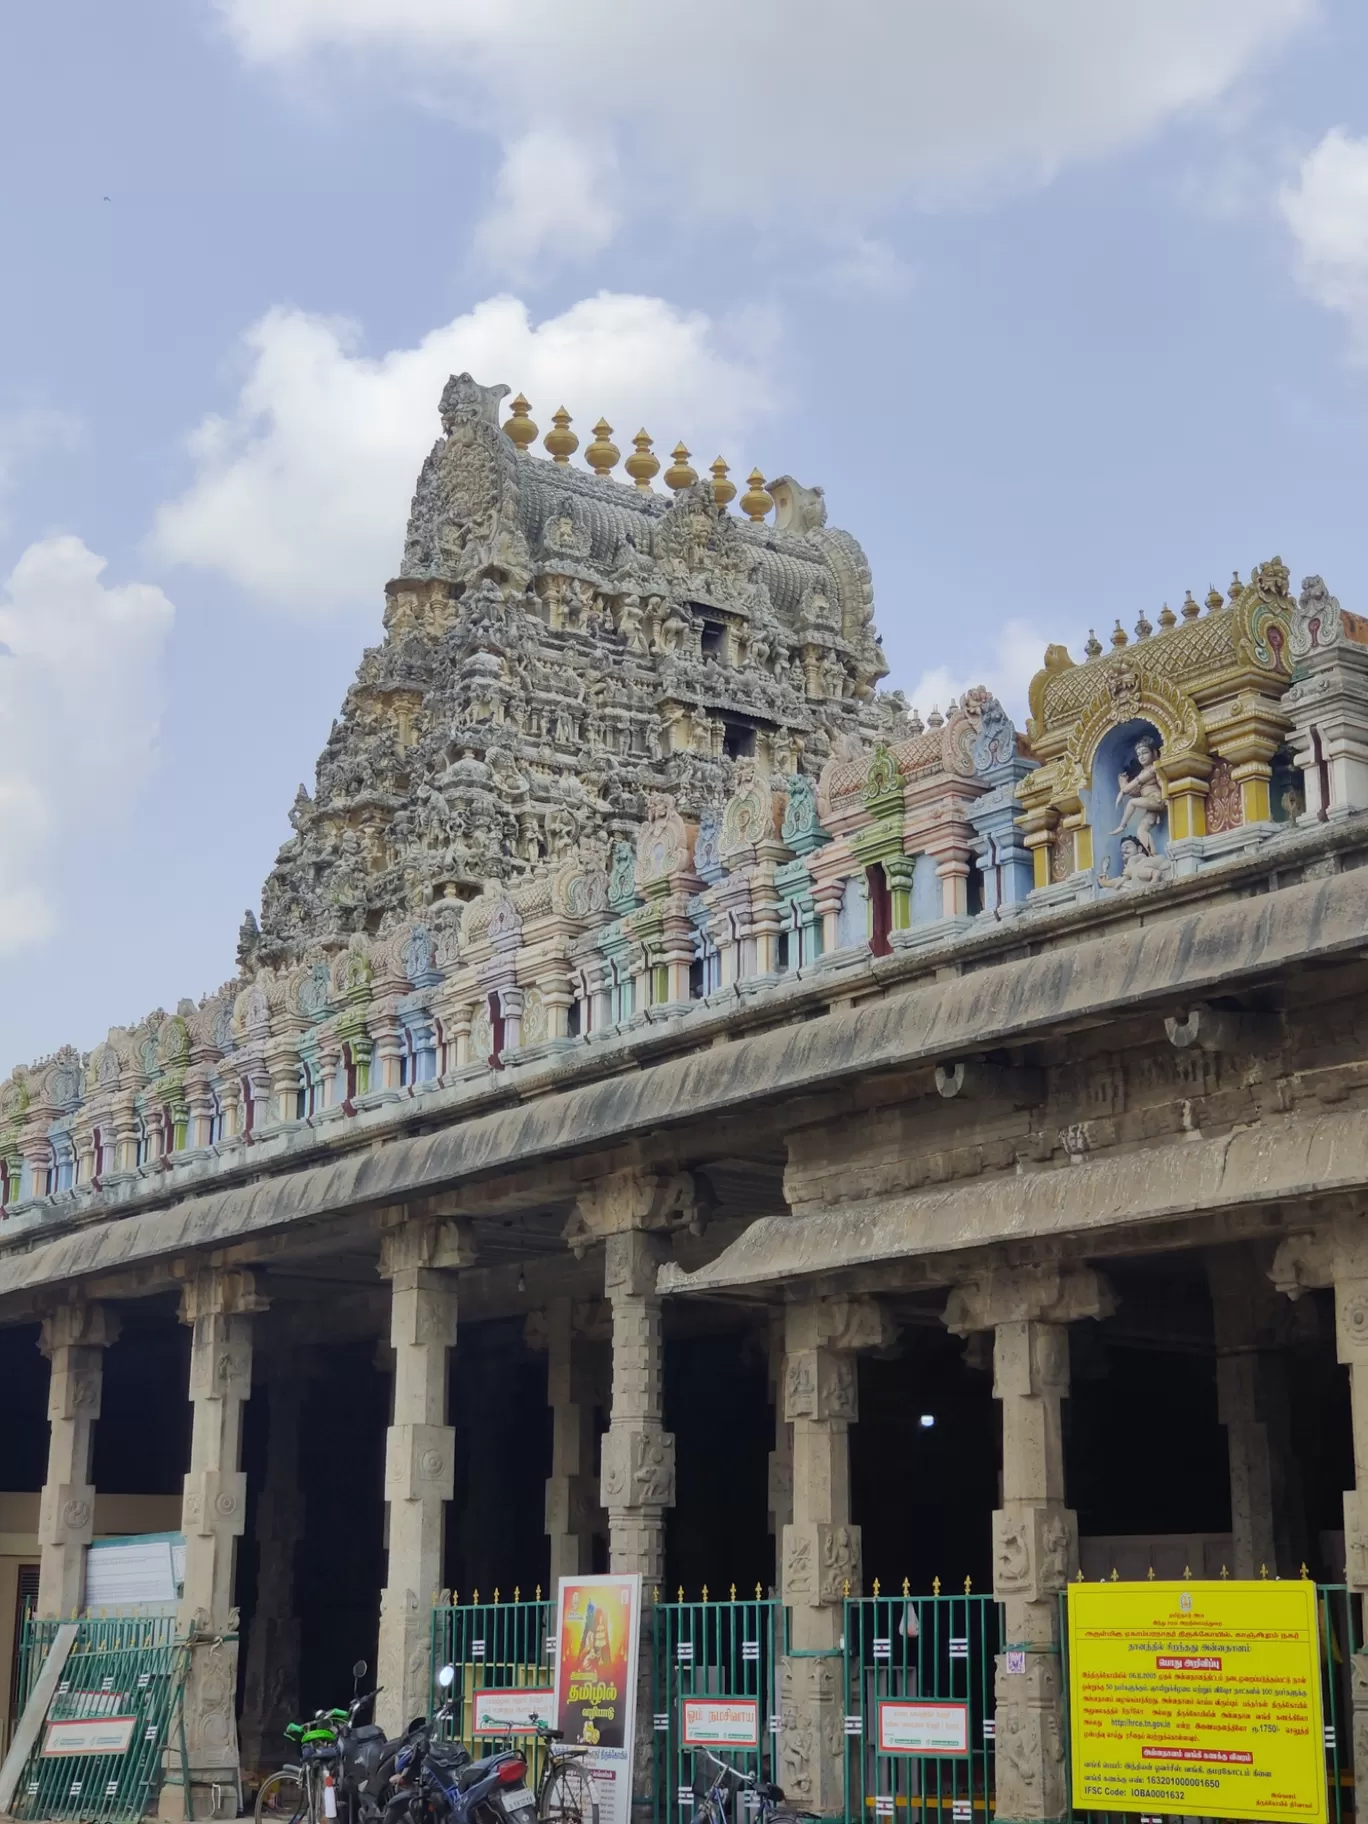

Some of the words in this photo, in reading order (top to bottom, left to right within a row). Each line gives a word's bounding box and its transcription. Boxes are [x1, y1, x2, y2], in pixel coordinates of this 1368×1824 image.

[1201, 1642, 1251, 1652] அன்னதானம்
[1159, 1658, 1182, 1669] பொது
[1184, 1658, 1219, 1669] அறிவிப்பு
[567, 1682, 617, 1705] தமிழில்
[581, 1706, 615, 1720] வழிபாடு
[1084, 1786, 1102, 1794] IFSC
[1104, 1787, 1126, 1796] Code:
[1131, 1788, 1184, 1799] IOBA0001632
